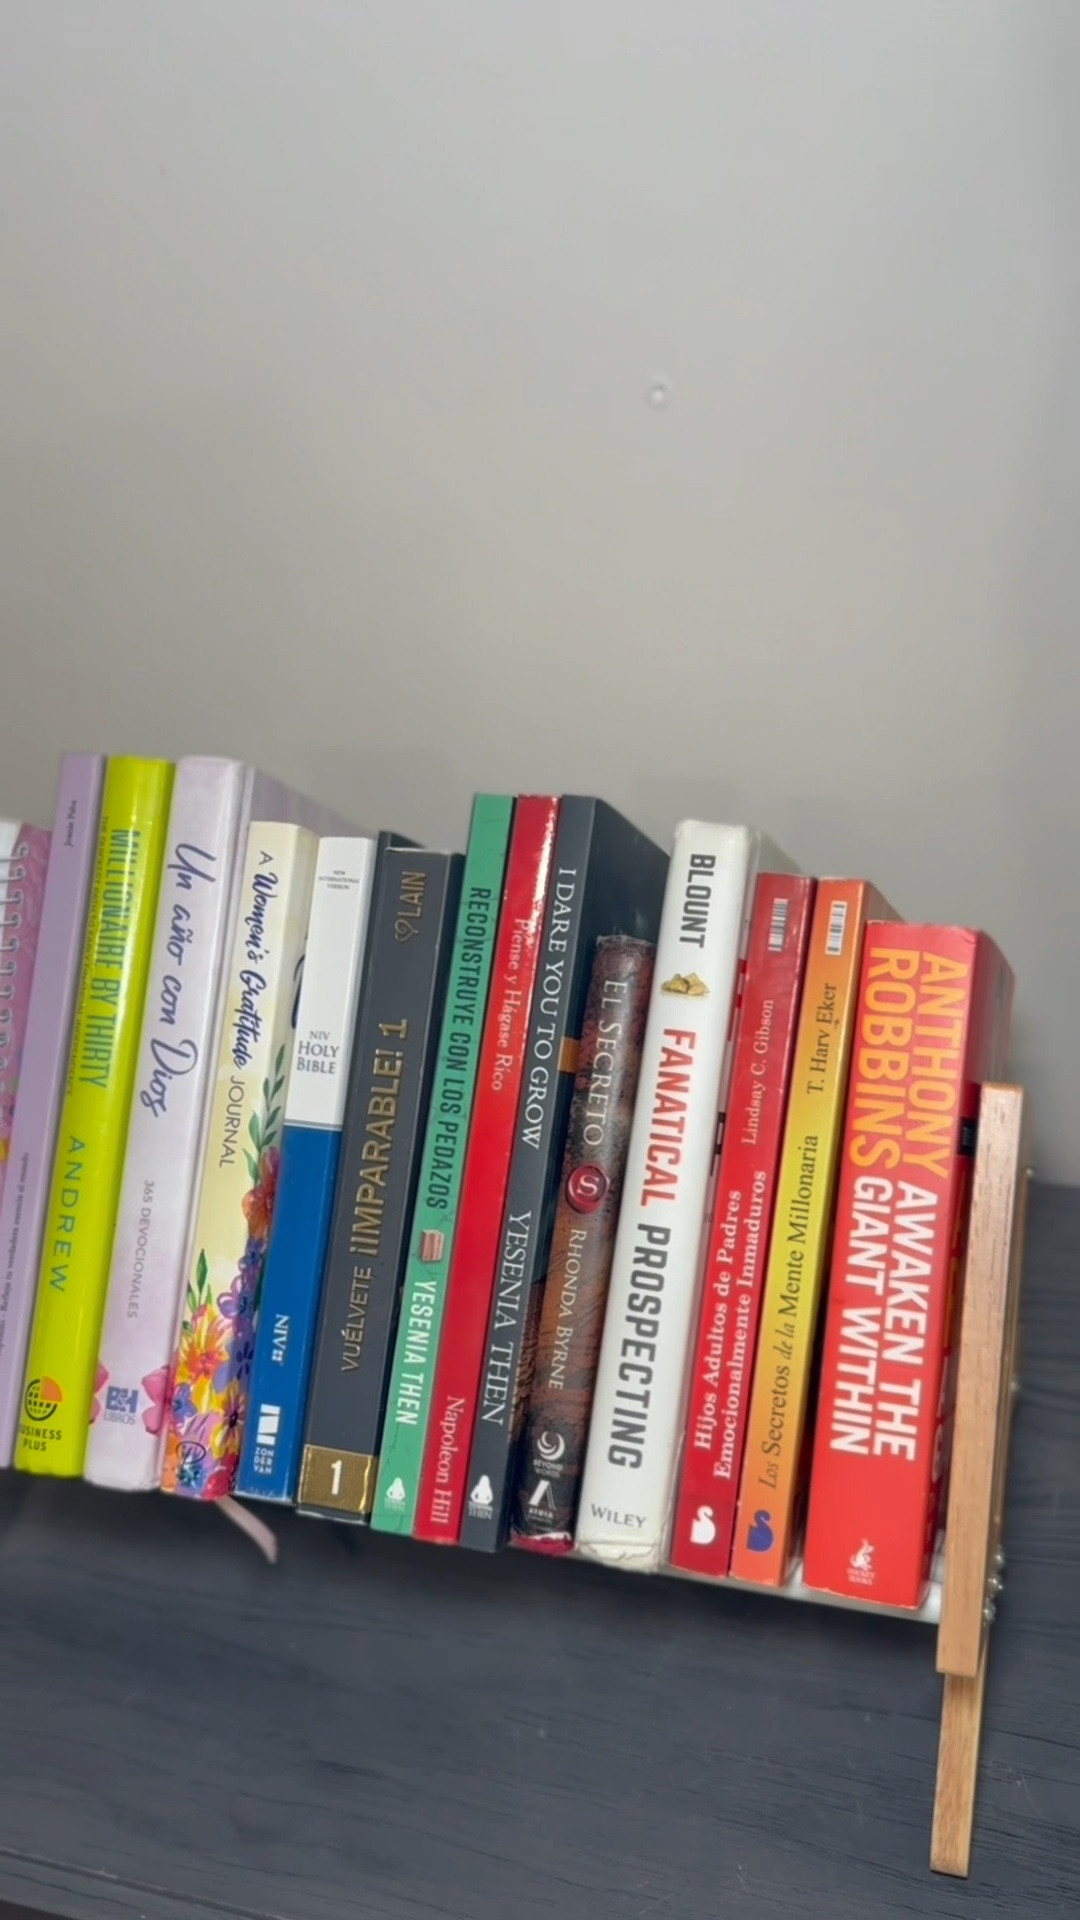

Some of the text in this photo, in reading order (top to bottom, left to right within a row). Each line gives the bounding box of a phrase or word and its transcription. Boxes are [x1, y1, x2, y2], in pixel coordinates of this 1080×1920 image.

[398, 870, 427, 918] LAIN
[679, 853, 717, 949] BLOUNT
[78, 828, 140, 1088] MILLIONAIRE BY THIRTY
[139, 843, 217, 1119] Un año con Dios
[218, 850, 279, 1168] A Women's Gratitude JOURNAL
[496, 988, 522, 1048] Hágase
[503, 973, 518, 985] y
[522, 867, 577, 1150] I DARE YOU TO GROW
[296, 1056, 337, 1074] BIBLE
[297, 1041, 340, 1059] HOLY
[309, 1030, 331, 1042] NIV
[425, 886, 492, 1211] RECONSTRUYE CON LOS PEDAZOS
[491, 1051, 513, 1092] Rico
[582, 980, 628, 1146] EL SECRETO
[741, 999, 774, 1145] Lindsay C. Gibson
[806, 982, 837, 1096] T. Harv Eker
[848, 947, 921, 1170] ROBBINS
[901, 951, 969, 1180] ANTHONY
[49, 1134, 86, 1292] ANDREW
[126, 1179, 155, 1319] 365 DEVOCIONALES
[340, 1266, 372, 1374] VUÉLVETE
[378, 1018, 409, 1040] 1
[607, 1027, 698, 1470] FANATICAL PROSPECTING
[716, 1189, 742, 1265] Padres
[271, 1313, 290, 1350] NIV
[481, 1210, 532, 1426] YESENIA THEN
[547, 1228, 588, 1391] RHONDA BYRNE
[713, 1269, 732, 1298] de
[713, 1170, 767, 1481] Emocionalmente Inmaduros
[758, 1134, 819, 1490] Los Secretos de la Mente Millonaria
[829, 1175, 894, 1457] GIANT WITHIN
[882, 1180, 939, 1367] AWAKEN
[395, 1280, 438, 1426] YESENIA THEN
[702, 1302, 728, 1388] Adultos
[17, 1424, 63, 1441] USINESS
[22, 1438, 47, 1452] PLUS
[253, 1456, 273, 1466] DER
[253, 1464, 273, 1475] VAN
[330, 1459, 343, 1496] 1
[429, 1394, 465, 1524] Napoleon Hill
[693, 1391, 718, 1450] Hijos
[873, 1378, 923, 1462] THE
[590, 1503, 648, 1529] WILEY
